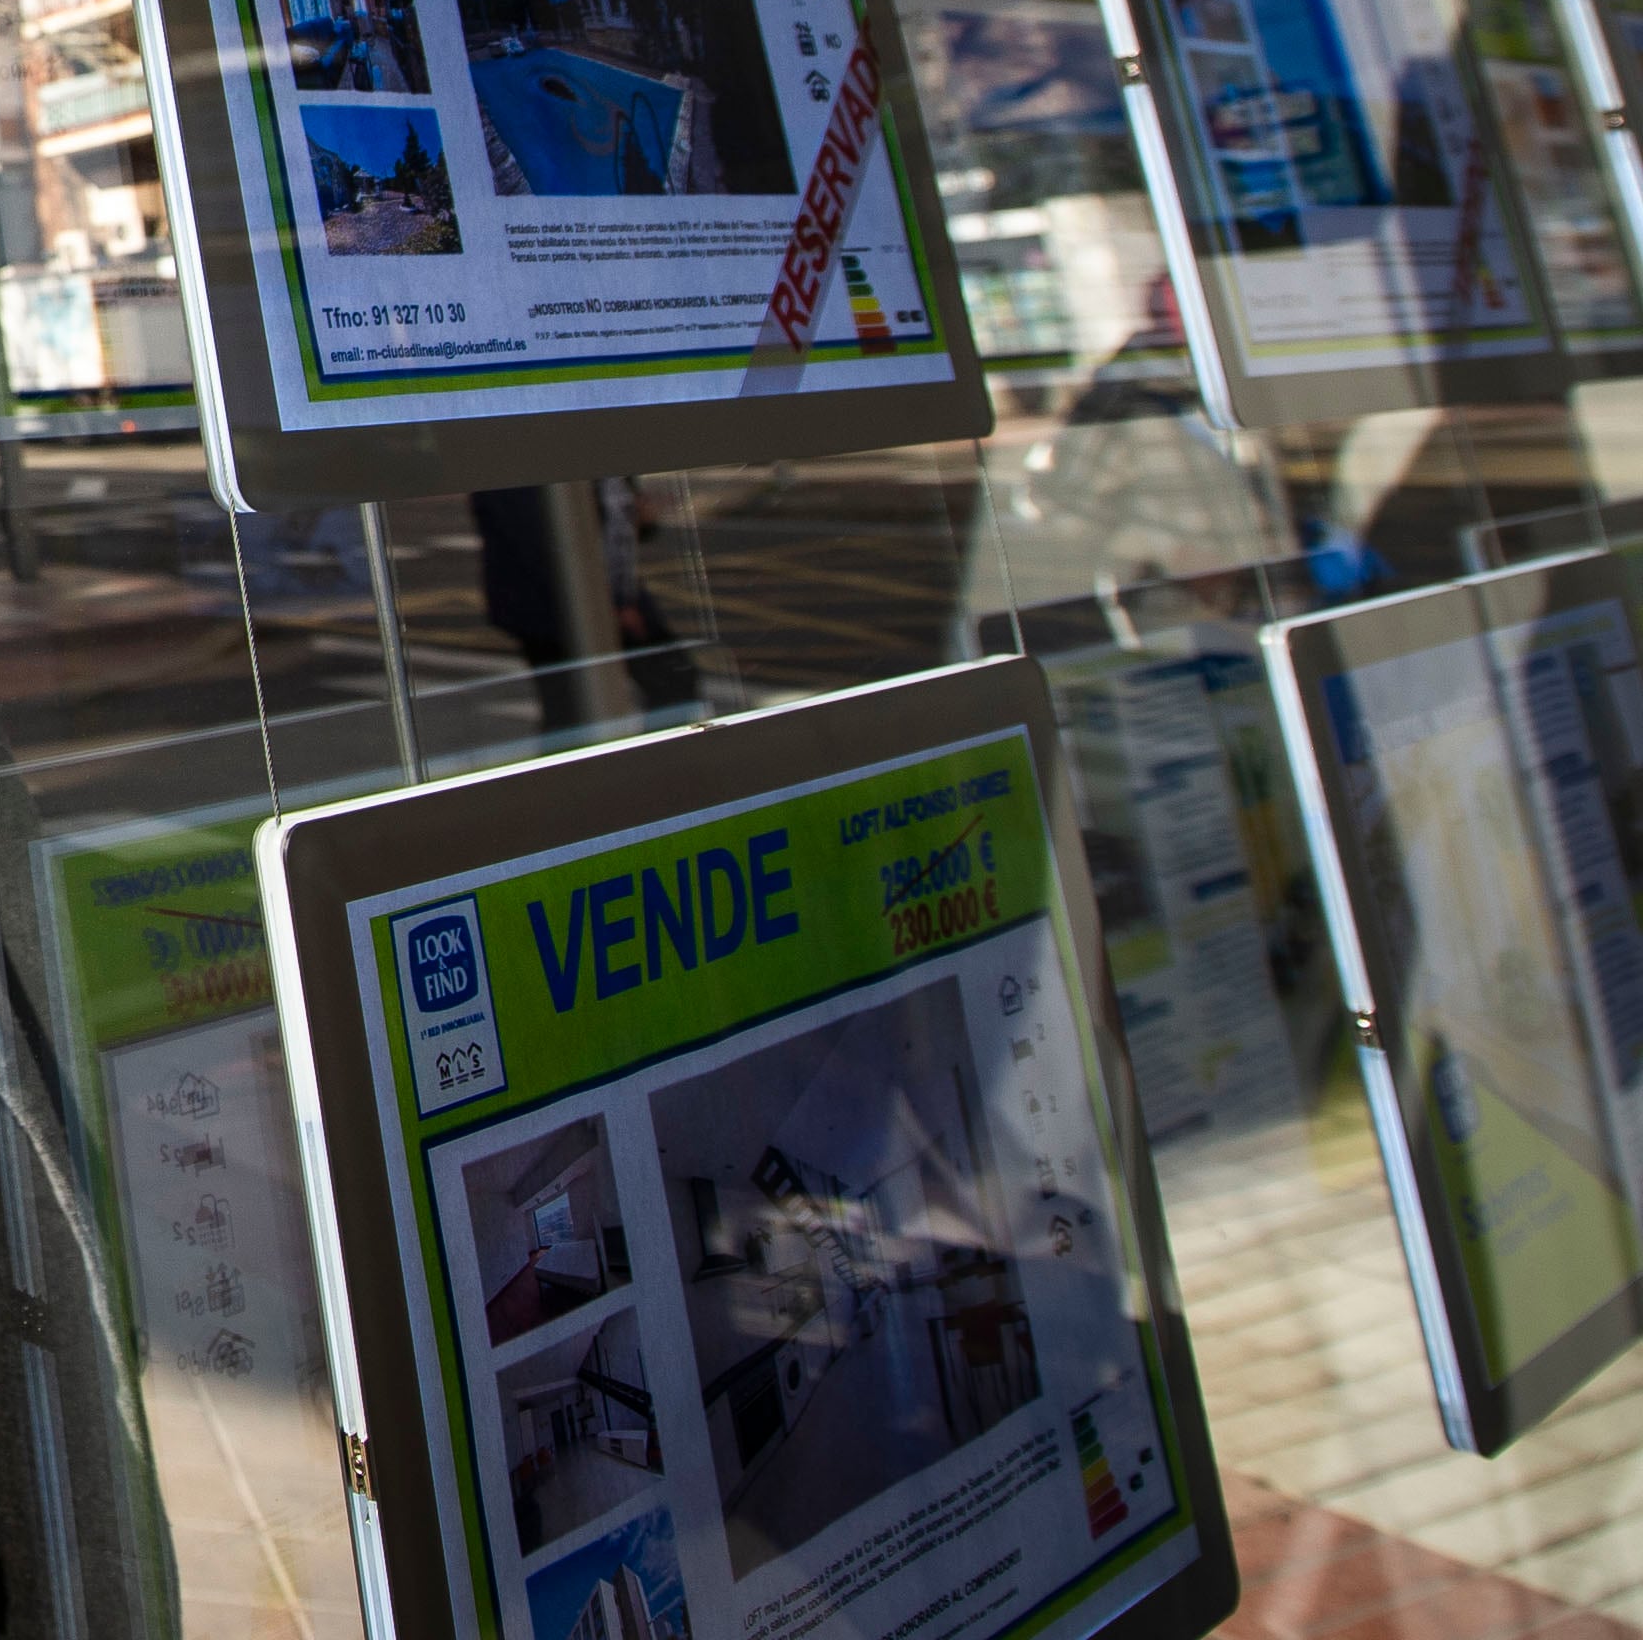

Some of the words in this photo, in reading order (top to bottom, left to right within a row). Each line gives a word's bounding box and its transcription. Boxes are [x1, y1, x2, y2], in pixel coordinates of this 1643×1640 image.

[770, 15, 882, 355] RESERVAD
[322, 307, 368, 329] Tfno:
[373, 305, 390, 326] 91
[395, 304, 420, 325] 327
[425, 303, 444, 324] 10
[449, 302, 466, 323] 30
[330, 346, 365, 364] email:
[366, 338, 527, 361] m-ciudadlineal@lookandfind.es
[979, 830, 996, 873] €
[527, 828, 800, 1014] VENDE
[890, 887, 980, 957] 230.000
[984, 877, 1000, 920] €
[415, 927, 466, 965] LOOK
[424, 965, 468, 1002] FIND
